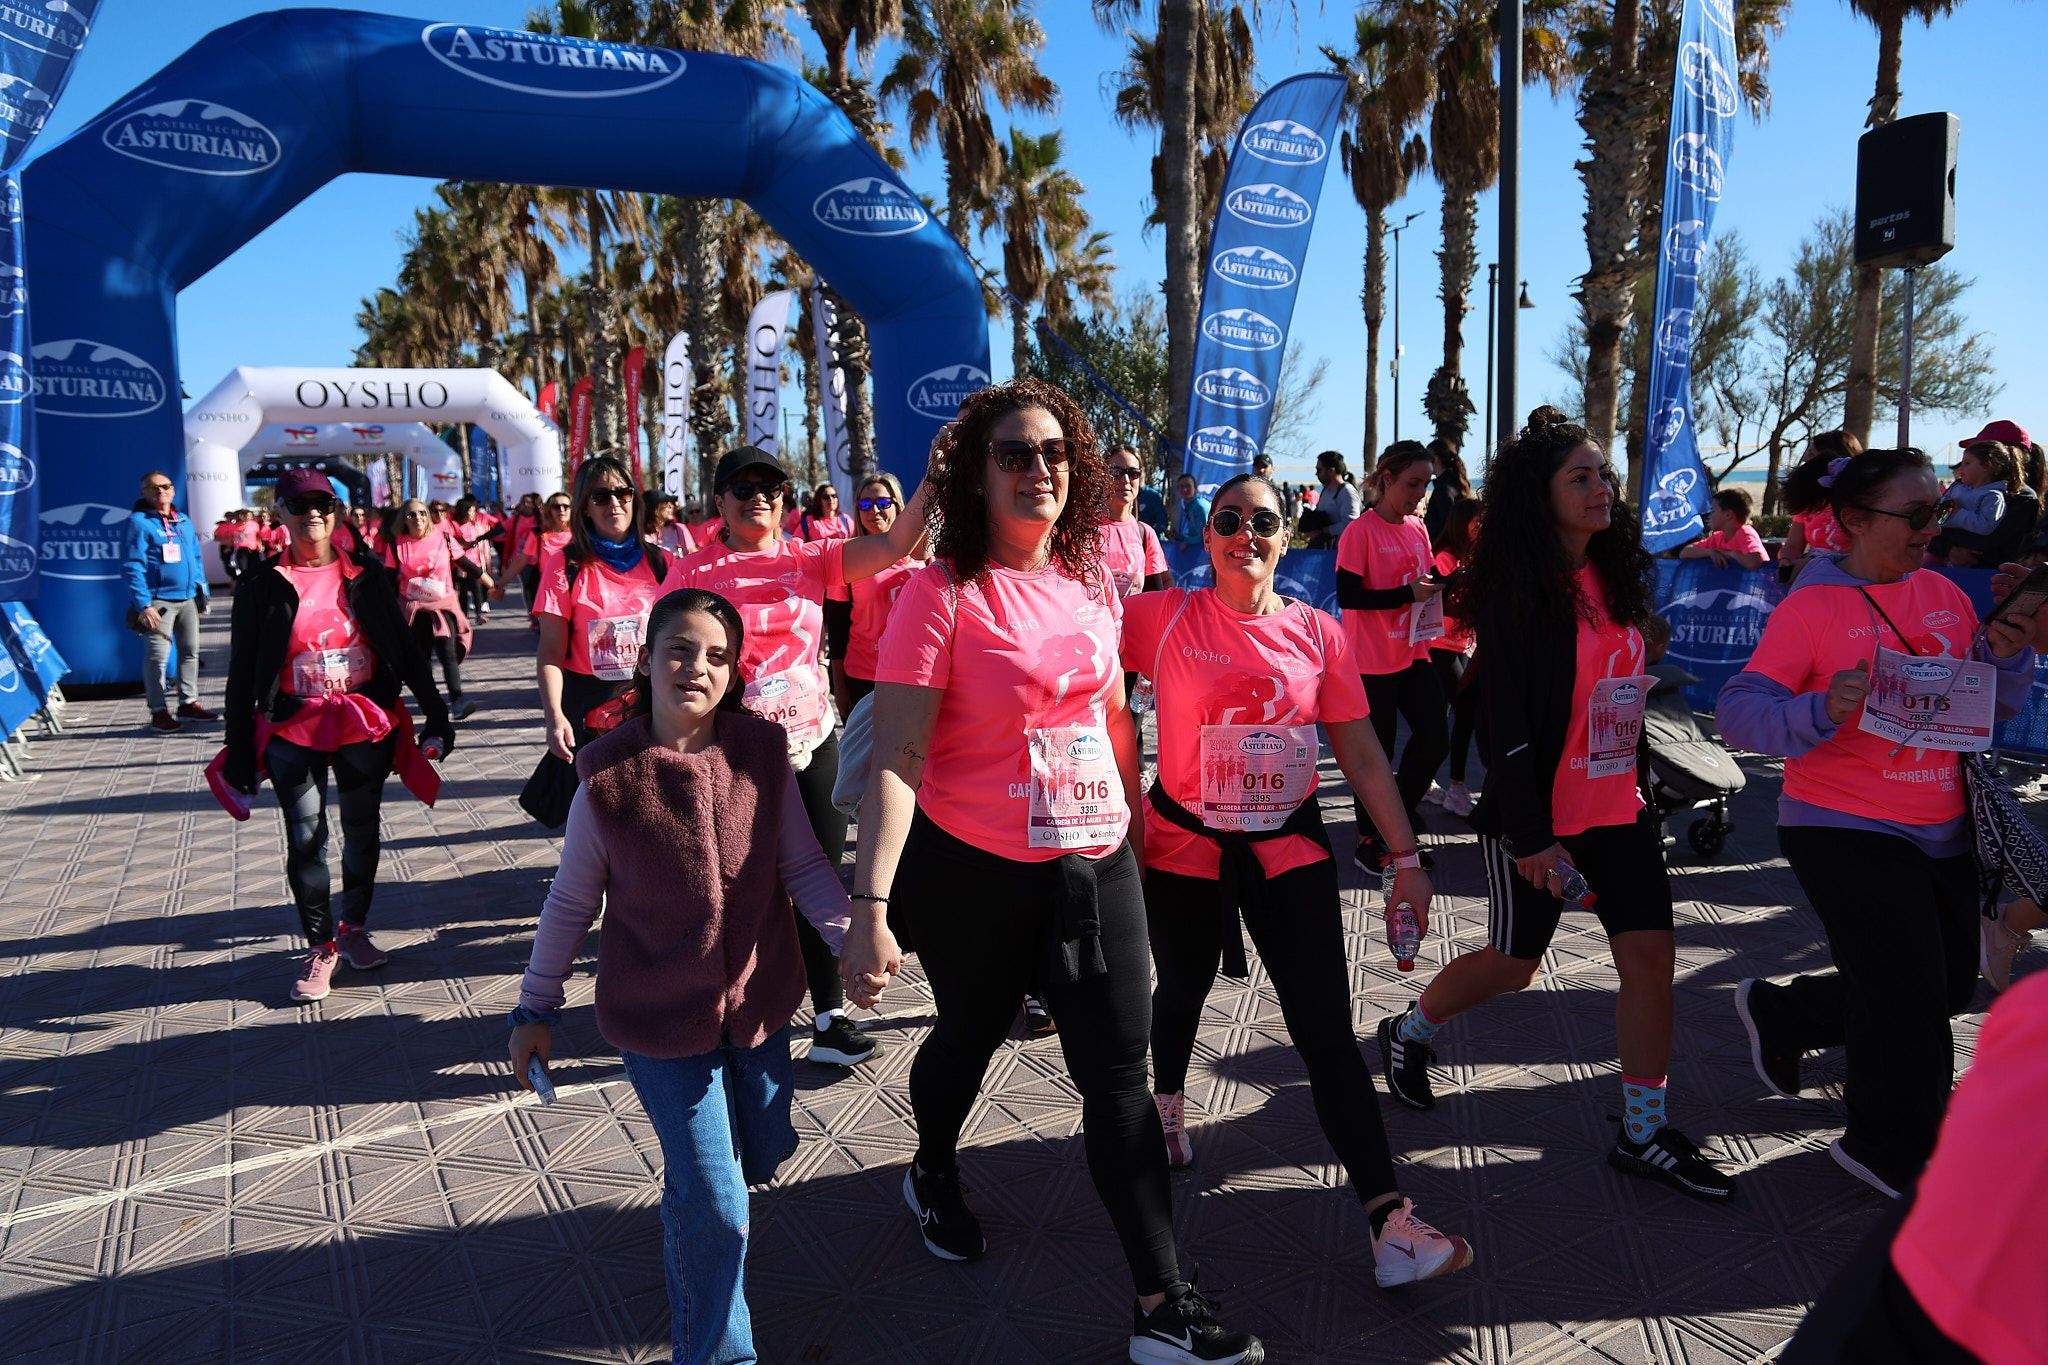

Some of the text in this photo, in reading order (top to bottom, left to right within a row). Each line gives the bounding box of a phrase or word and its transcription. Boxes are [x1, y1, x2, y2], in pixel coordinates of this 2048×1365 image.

[447, 27, 671, 74] ASTURIANA
[115, 123, 268, 163] ASTURIANA
[1247, 131, 1319, 158] ASTURIANA
[824, 198, 922, 222] ASTURIANA
[1232, 194, 1303, 222] ASTURIANA
[1219, 256, 1288, 283] ASTURIANA
[1209, 320, 1275, 344] ASTURIANA
[296, 379, 449, 410] OYSHO
[753, 324, 778, 449] YSHO
[1201, 378, 1264, 403] ASTURIANA
[198, 412, 250, 423] OYSHO
[666, 361, 685, 494] OYSHO
[1195, 436, 1254, 460] ASTURIANA
[1183, 646, 1231, 665] OYSHO
[1905, 667, 1949, 677] ASTURIANA
[325, 677, 353, 690] 016
[1903, 695, 1950, 712] 016
[768, 706, 797, 723] 016
[1615, 719, 1637, 737] 016
[1874, 720, 1907, 740] OYSHO
[1944, 725, 1974, 734] VALENCIA
[1242, 741, 1283, 750] ASTURIANA
[1933, 735, 1976, 747] Santander
[1243, 773, 1285, 789] 016
[1882, 769, 1937, 783] CARRERA
[1938, 767, 1951, 780] DE
[1073, 780, 1109, 800] 016
[1250, 794, 1271, 802] 3395
[1080, 805, 1098, 815] 3393
[1046, 818, 1071, 826] CARRERA
[1216, 814, 1251, 825] OYSHO
[1043, 830, 1080, 841] OYSHO
